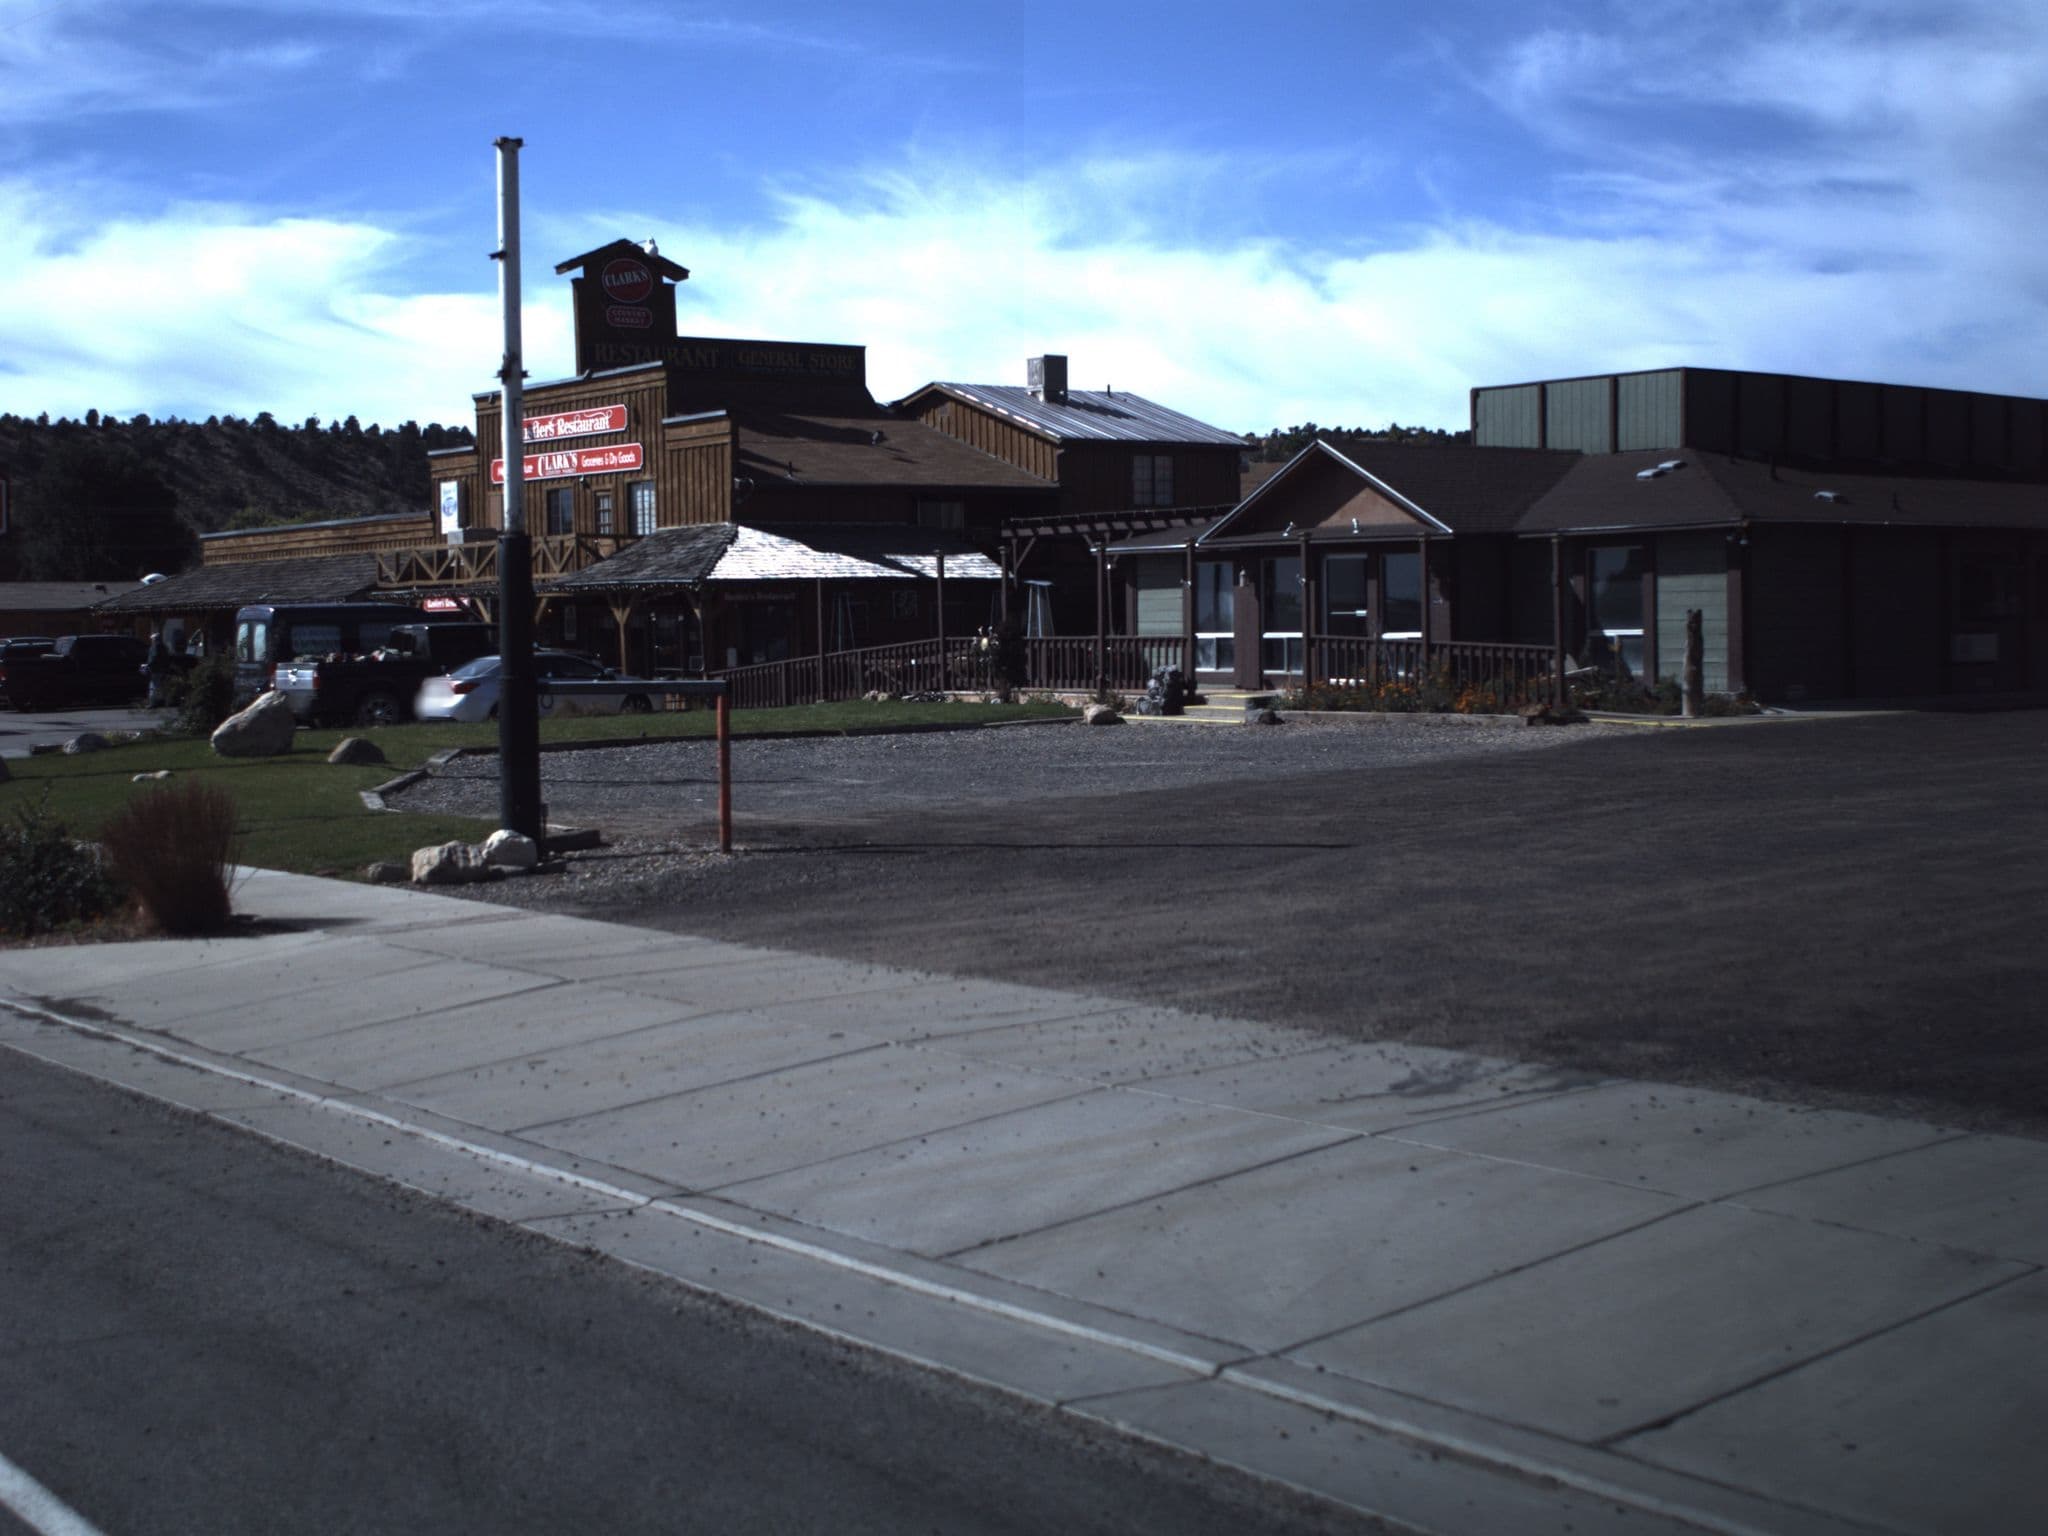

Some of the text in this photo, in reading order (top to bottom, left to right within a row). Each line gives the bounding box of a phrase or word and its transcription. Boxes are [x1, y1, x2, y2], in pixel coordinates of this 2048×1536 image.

[595, 344, 857, 370] RESTAURANT GENERAL STORE
[557, 411, 612, 435] Restaurant
[538, 452, 578, 476] CLARK'S
[618, 450, 636, 464] Goods
